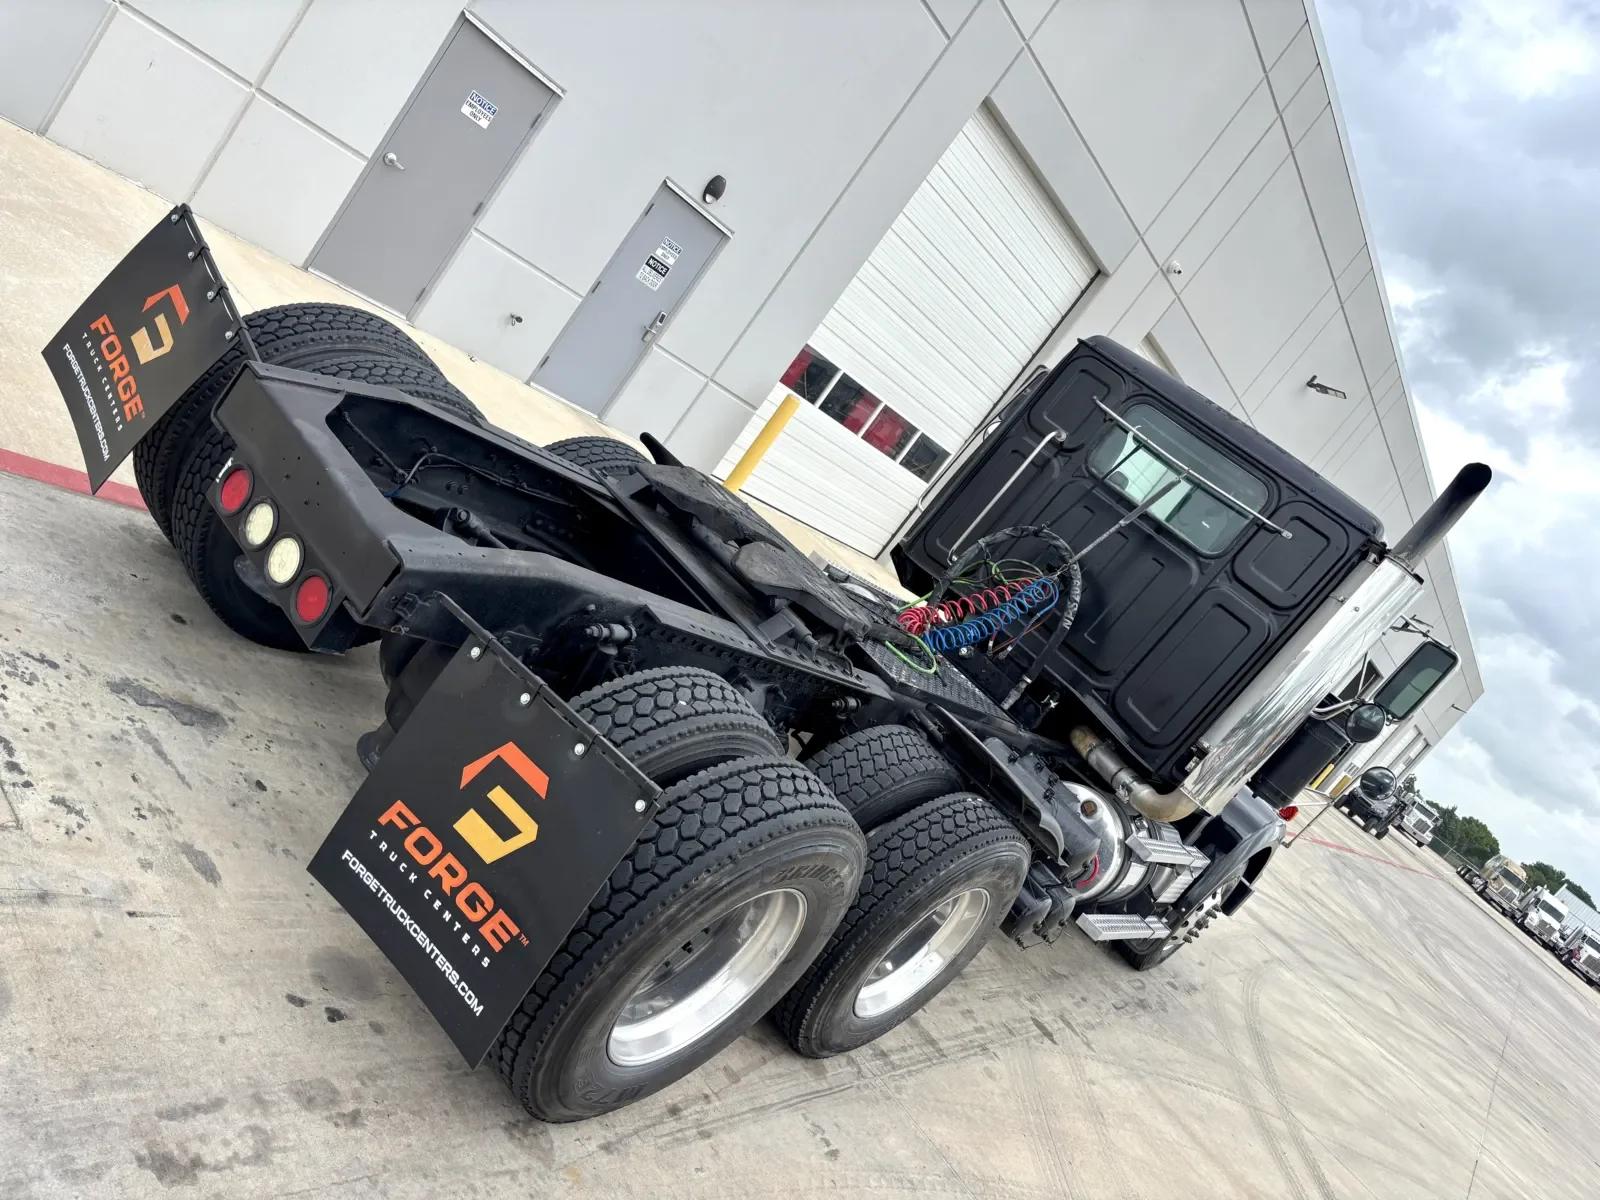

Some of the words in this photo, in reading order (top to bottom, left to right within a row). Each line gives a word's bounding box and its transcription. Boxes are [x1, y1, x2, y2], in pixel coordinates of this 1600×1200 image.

[469, 111, 482, 122] ONLY
[471, 92, 497, 116] NOTICE
[647, 258, 668, 276] NOTICE
[662, 237, 682, 254] NOTICE
[62, 343, 111, 462] FORGETRUCKCENTERS.COM
[82, 332, 101, 373] TRUCK
[102, 376, 123, 432] CENTERS
[89, 314, 142, 422] FORGE
[368, 830, 418, 884] TRUCK
[423, 889, 491, 968] CENTERS
[377, 800, 520, 953] FORGE
[341, 849, 484, 1017] FORGETRUCKCENTERS.COM
